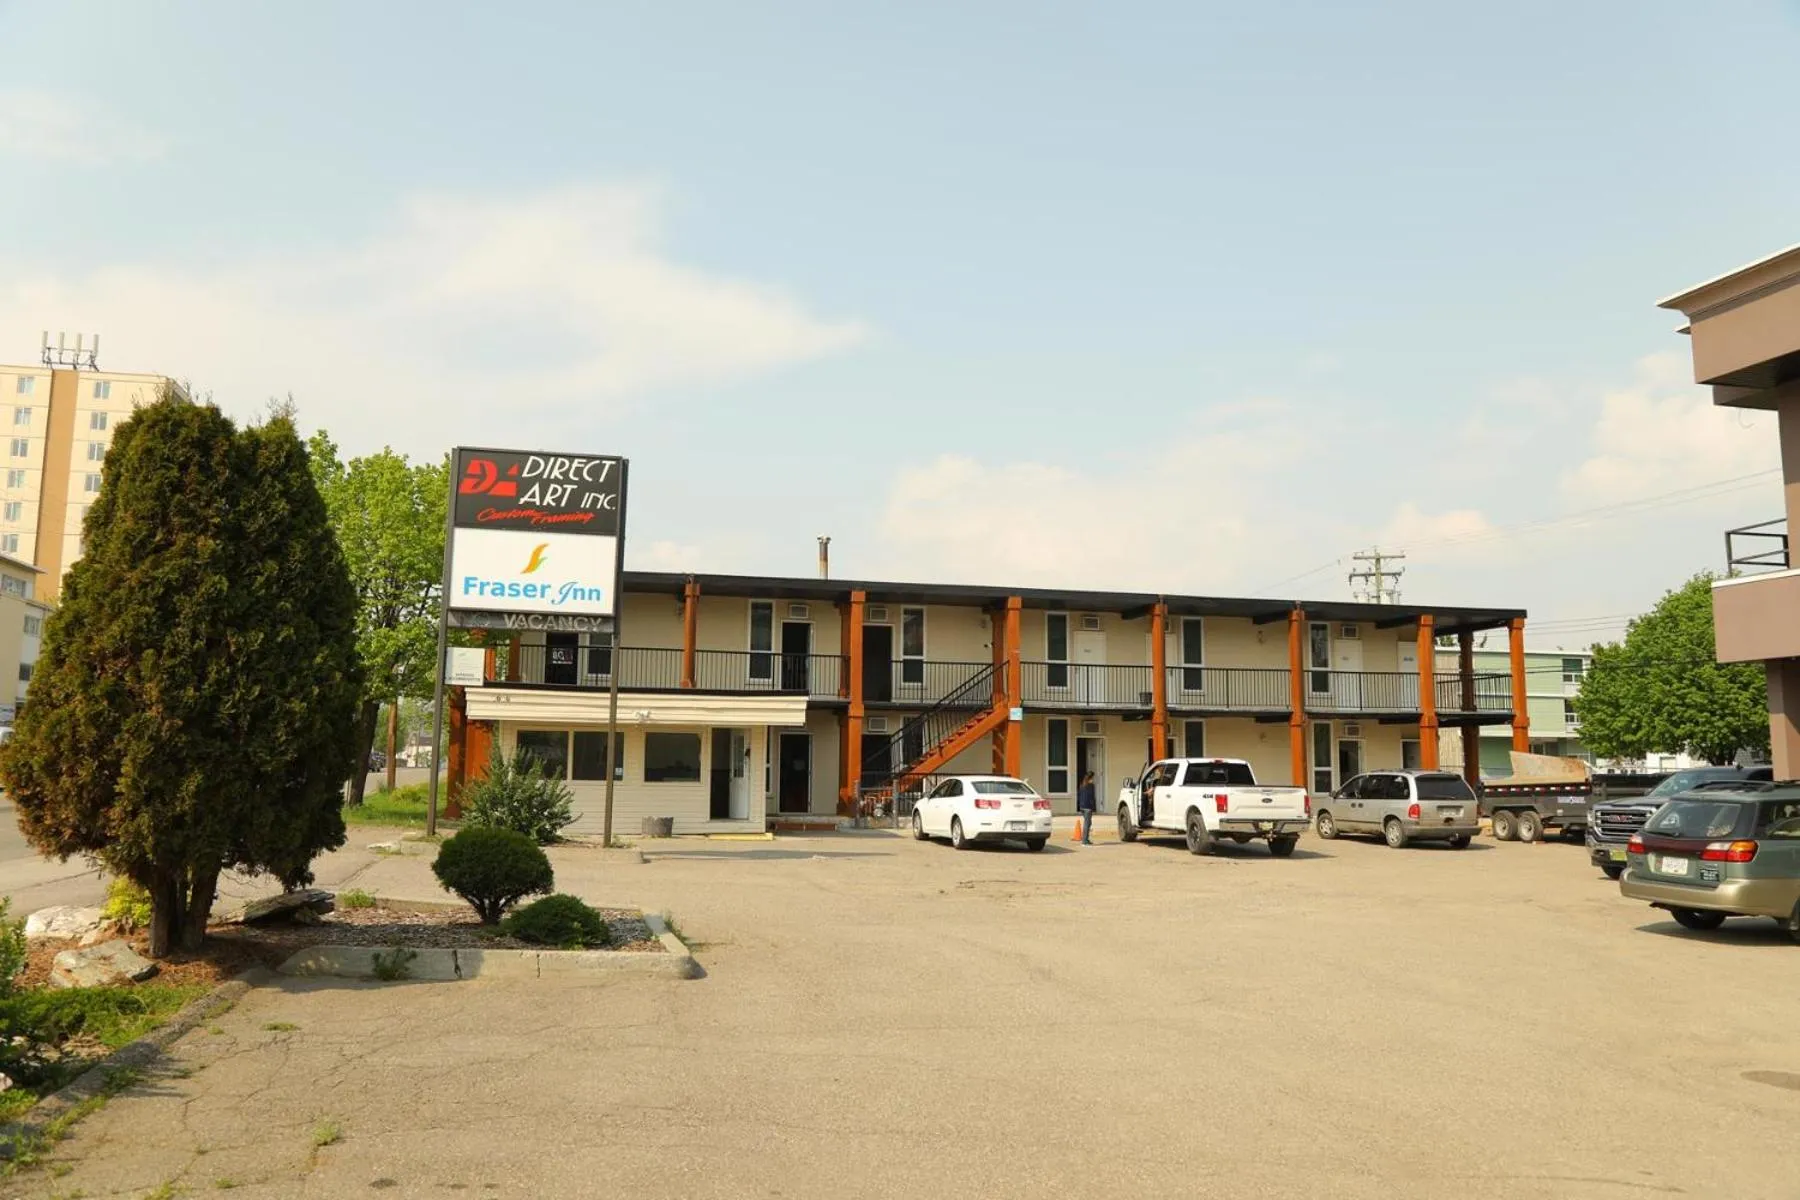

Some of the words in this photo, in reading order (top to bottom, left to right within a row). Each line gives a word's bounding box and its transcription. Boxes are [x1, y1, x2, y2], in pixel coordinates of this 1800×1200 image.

[522, 456, 616, 483] DIRECT
[518, 482, 577, 507] ART
[580, 492, 617, 510] INC.
[463, 576, 552, 599] Fraser
[551, 581, 601, 605] Inn
[503, 613, 602, 632] VACANCY
